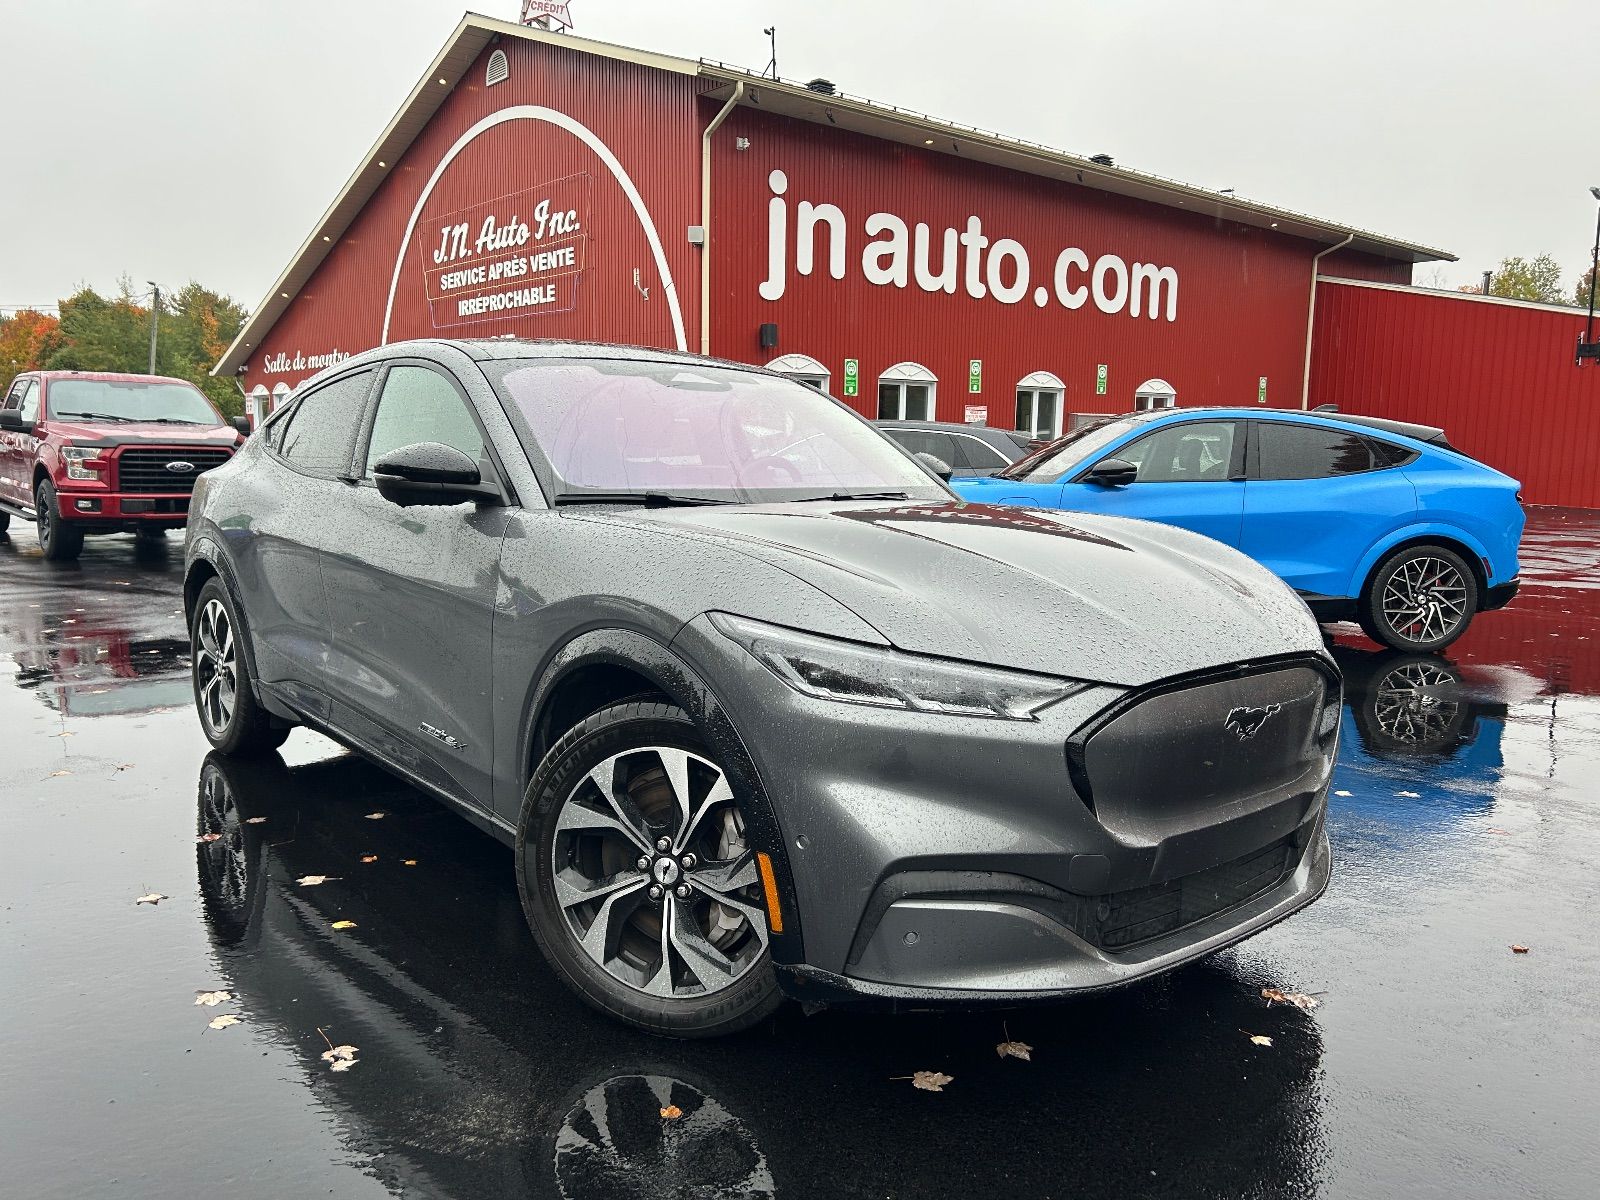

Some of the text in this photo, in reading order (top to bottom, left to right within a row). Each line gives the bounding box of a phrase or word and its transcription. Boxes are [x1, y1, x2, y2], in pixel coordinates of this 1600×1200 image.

[434, 200, 580, 264] J.N. Auto Inc.
[759, 170, 1178, 322] jn auto.com
[441, 247, 575, 290] SERVICE APRÈS VENTE
[459, 284, 555, 316] IRRÉPROCHABLE
[264, 352, 290, 373] Salle
[293, 350, 306, 370] de
